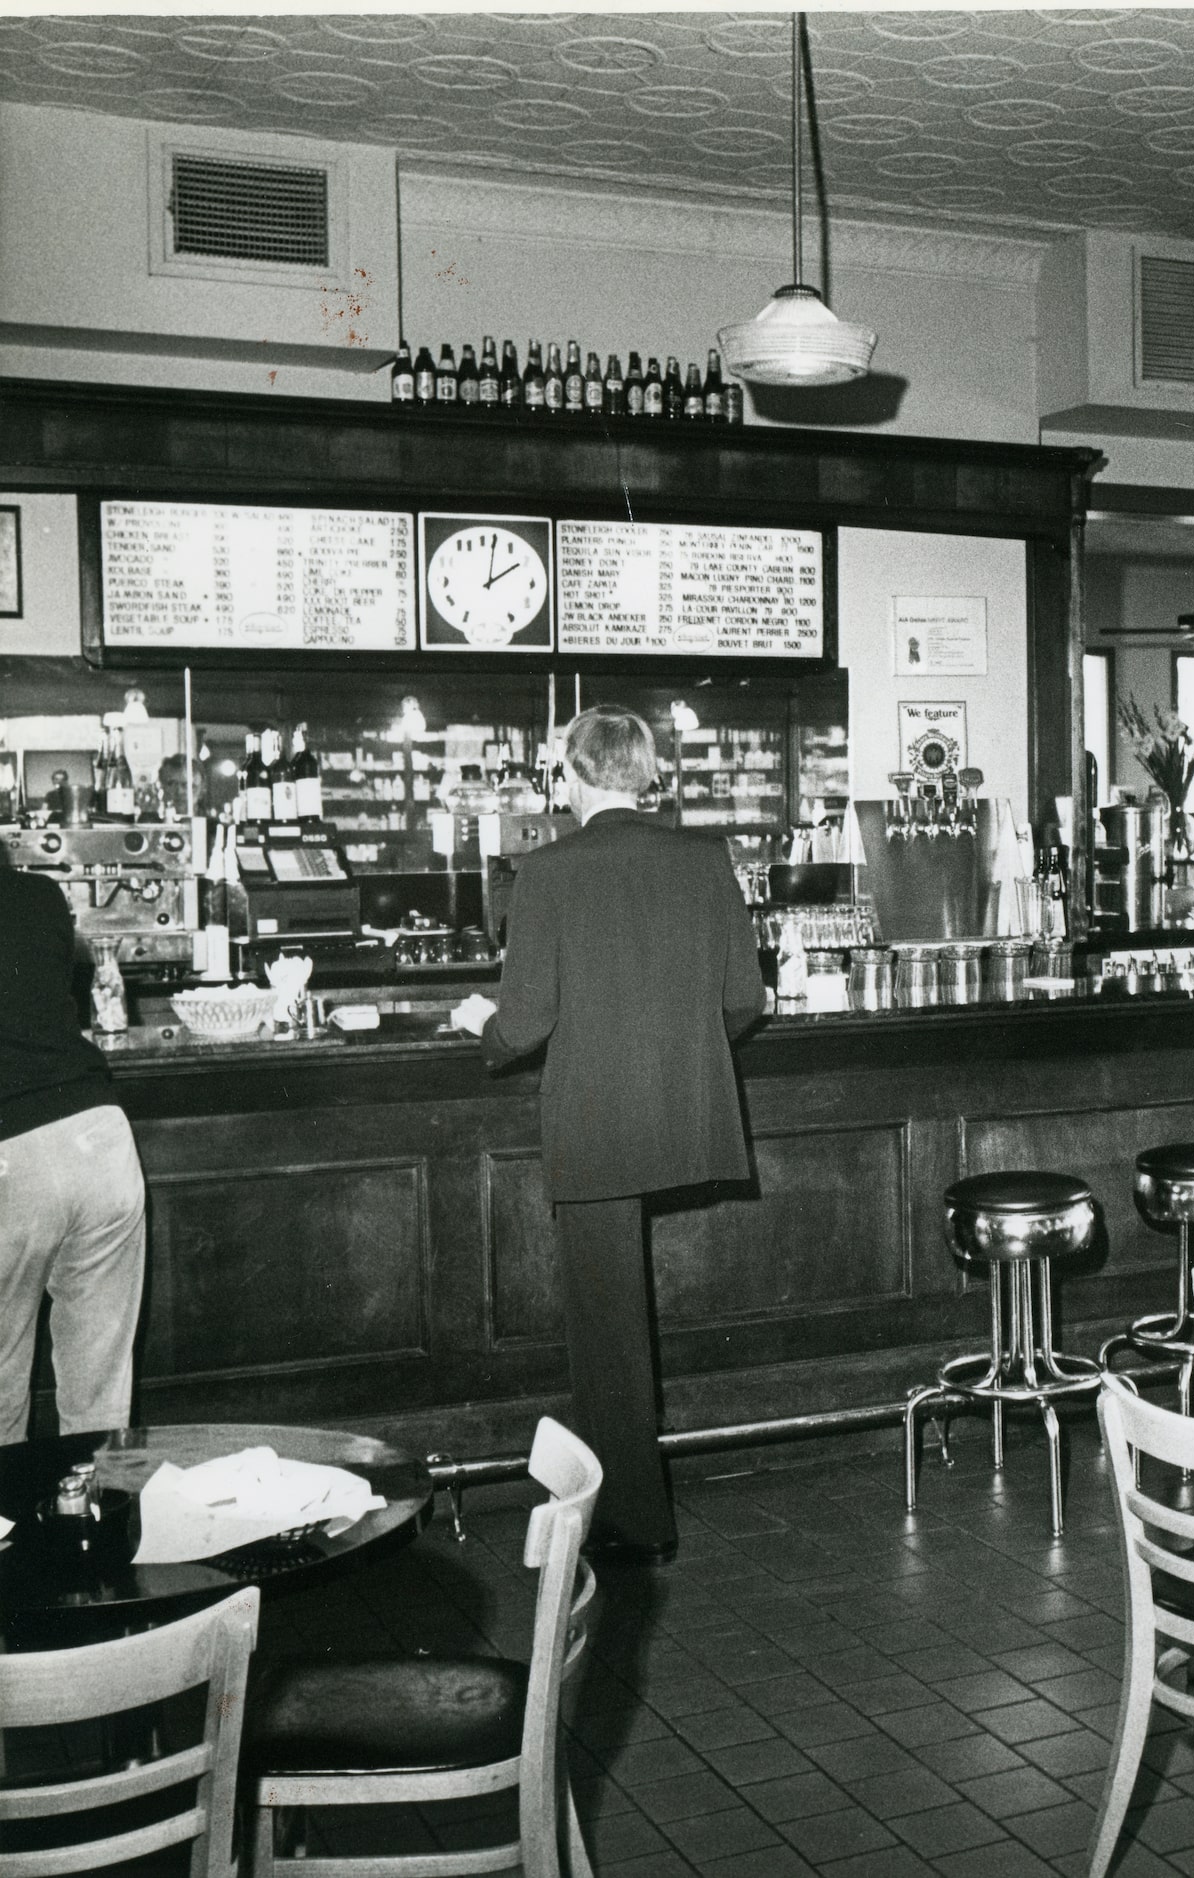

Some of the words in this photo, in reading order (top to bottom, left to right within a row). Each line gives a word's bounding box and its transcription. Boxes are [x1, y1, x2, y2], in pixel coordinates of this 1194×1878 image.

[358, 517, 390, 525] SALAD
[561, 525, 612, 533] STONELEIGH
[561, 536, 602, 544] PLANTERS
[561, 546, 598, 555] TEQUILA
[107, 554, 153, 562] AVOCADO
[721, 585, 770, 593] PIESPORTER
[682, 594, 724, 603] MIRASSOU
[109, 602, 168, 611] SWORDFISH
[171, 604, 201, 612] STEAK
[109, 614, 167, 623] VEGETABLE
[173, 615, 199, 623] SOUP
[762, 618, 788, 626] NEGRO
[757, 628, 789, 636] PERRIER
[606, 637, 618, 645] DU
[718, 640, 748, 648] BOUVET
[784, 641, 801, 650] 1500
[907, 708, 922, 718] We
[924, 708, 959, 718] feature
